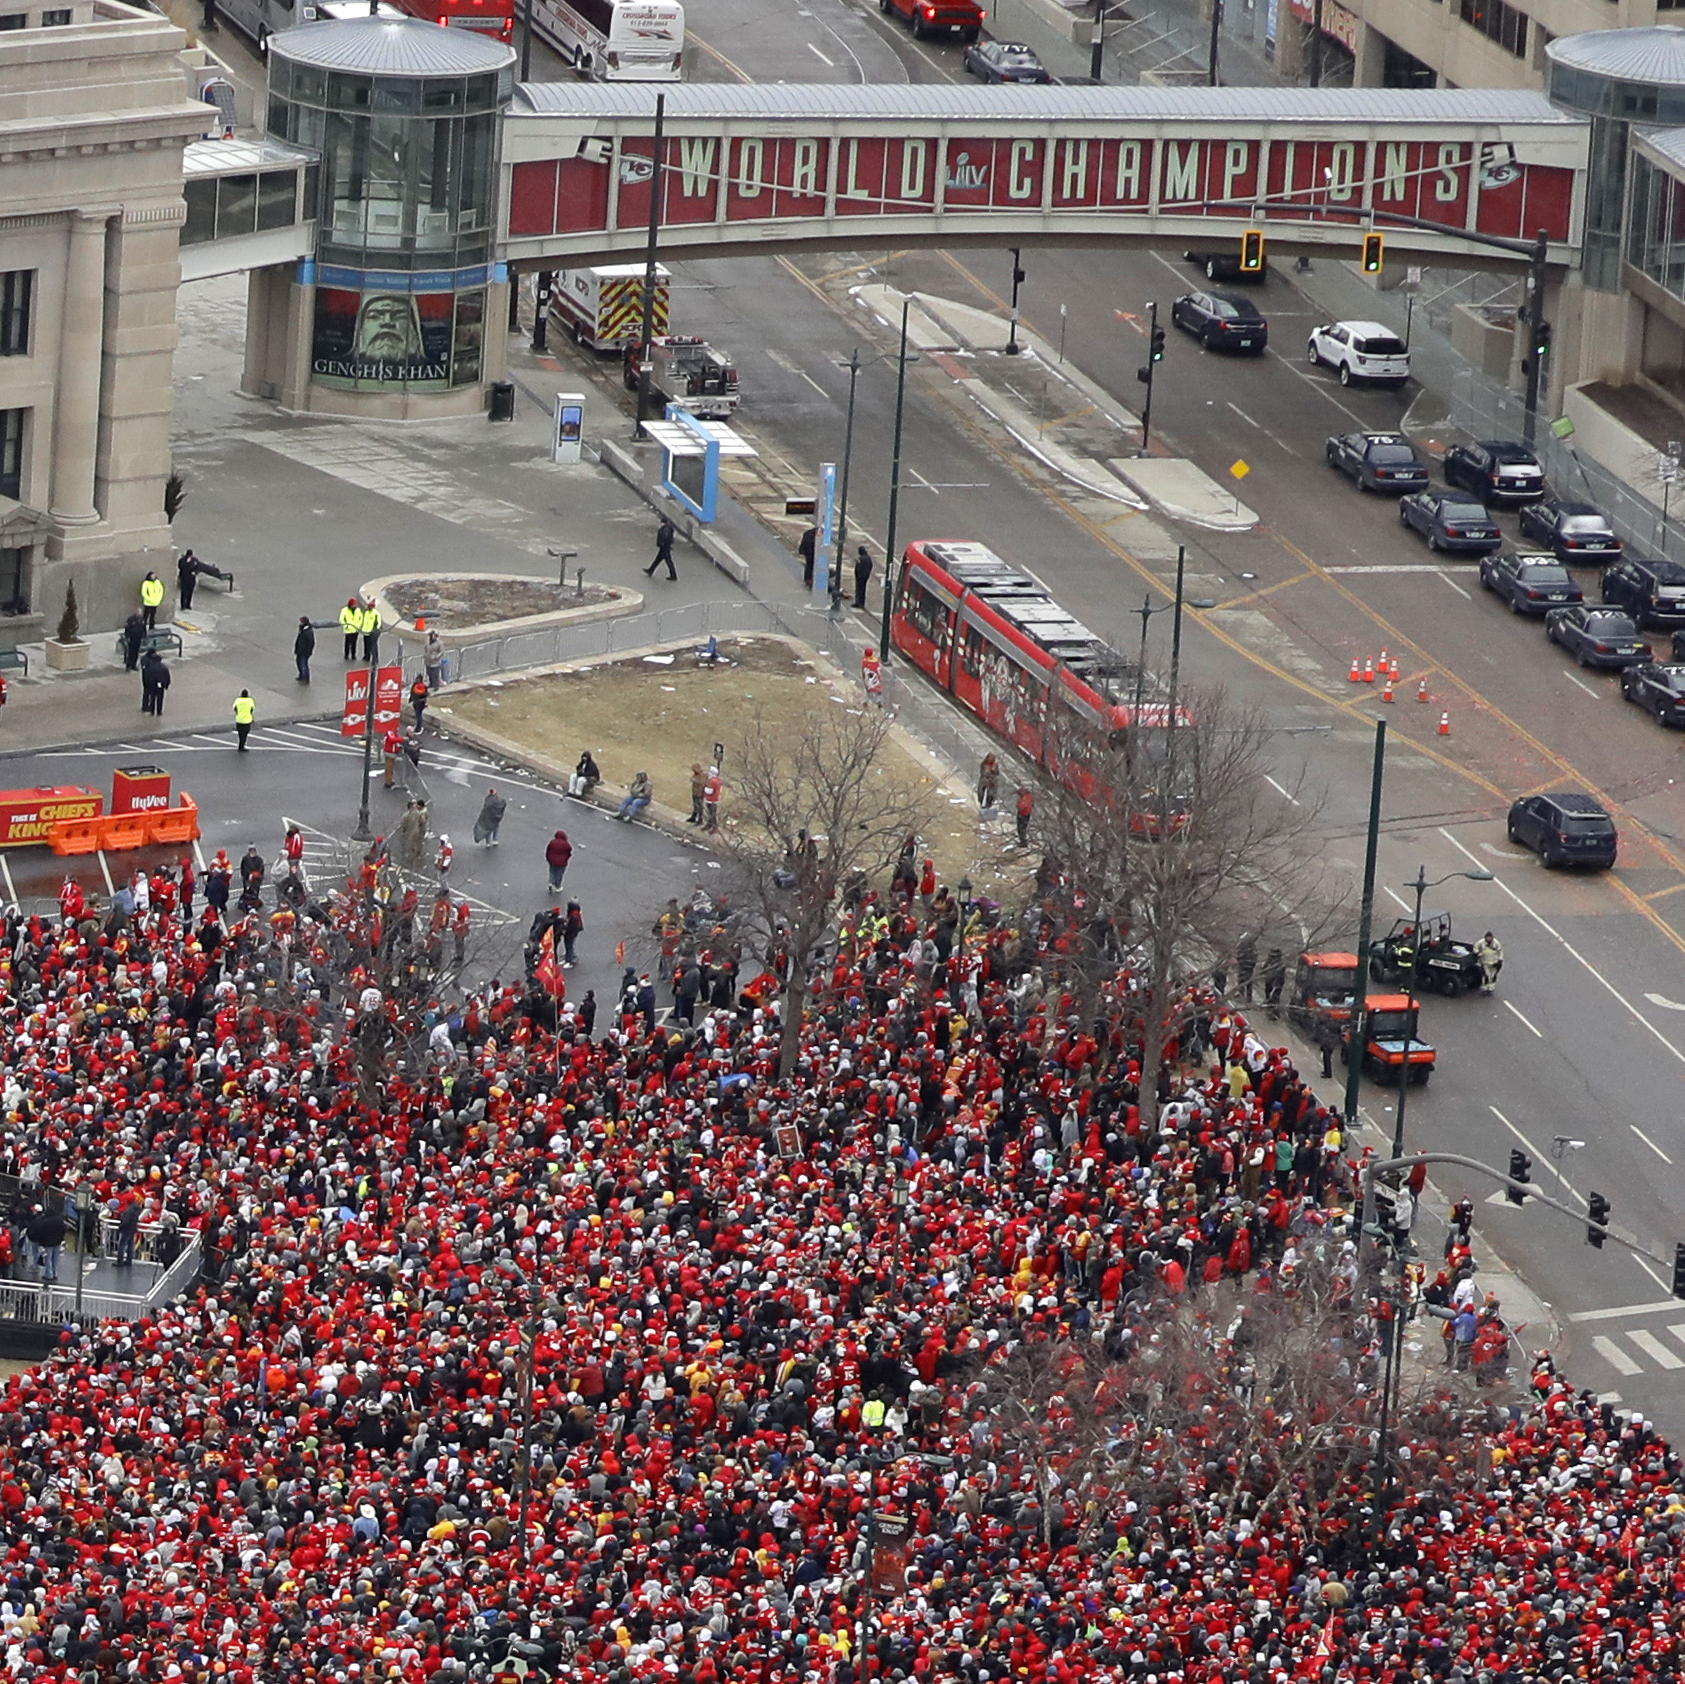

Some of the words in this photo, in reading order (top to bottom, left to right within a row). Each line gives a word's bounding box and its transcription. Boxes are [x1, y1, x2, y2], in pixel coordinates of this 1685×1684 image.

[680, 137, 925, 198] WORLD
[1009, 140, 1460, 202] CHAMPIONS
[315, 359, 393, 380] GENGHIS
[397, 364, 446, 380] KHAN
[40, 803, 96, 818] CHIEFS
[8, 823, 54, 839] KING
